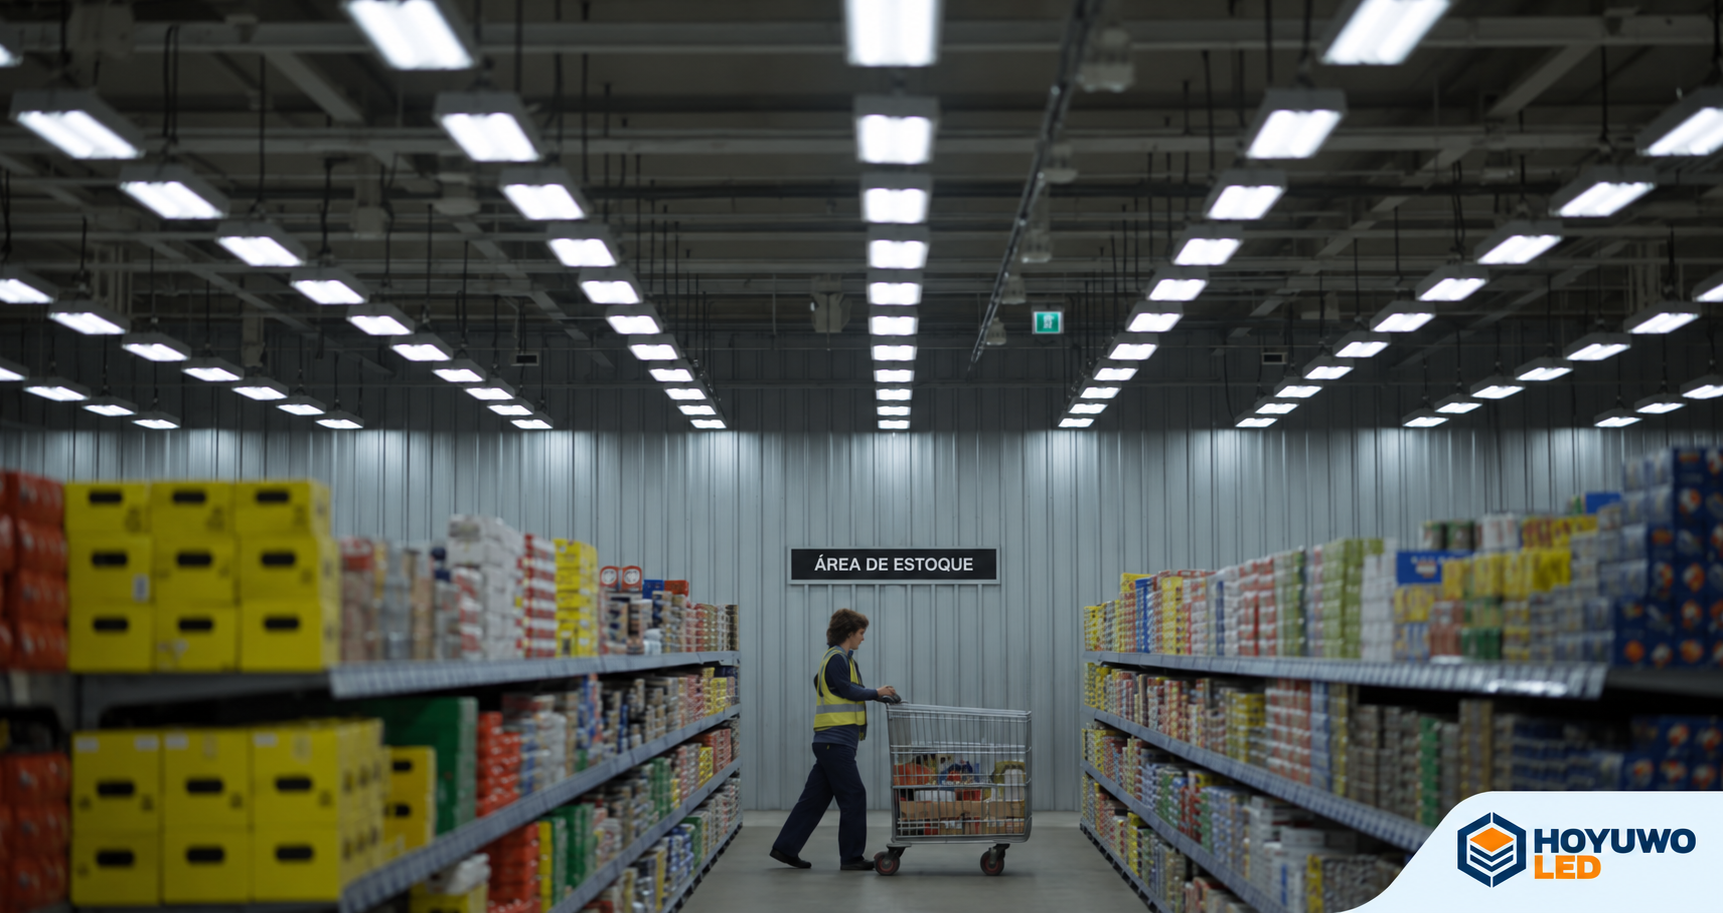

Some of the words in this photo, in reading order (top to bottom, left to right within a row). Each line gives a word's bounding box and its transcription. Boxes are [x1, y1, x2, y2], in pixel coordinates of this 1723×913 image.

[814, 554, 861, 571] ÁREA
[866, 557, 889, 571] DE
[894, 557, 973, 572] ESTOQUE
